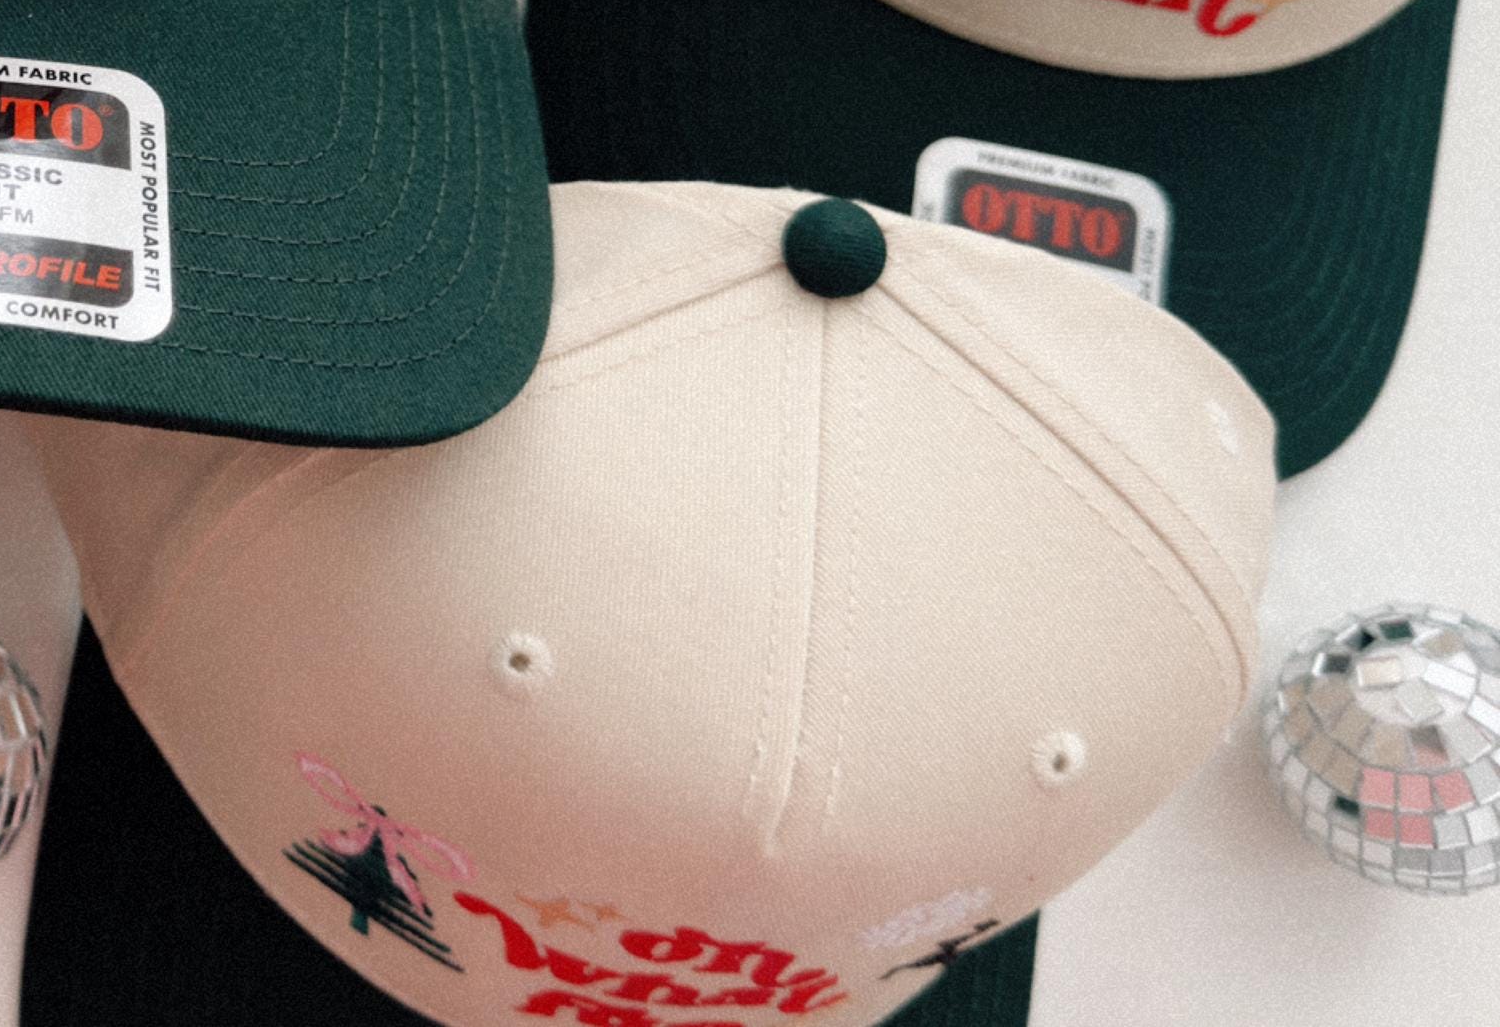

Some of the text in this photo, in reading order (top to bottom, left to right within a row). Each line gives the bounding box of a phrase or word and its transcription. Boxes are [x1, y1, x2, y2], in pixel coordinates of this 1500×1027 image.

[19, 66, 93, 85] FABRIC
[139, 121, 161, 292] MOST POPULAR FIT
[962, 182, 1121, 258] OTTO
[6, 301, 119, 331] COMFORT
